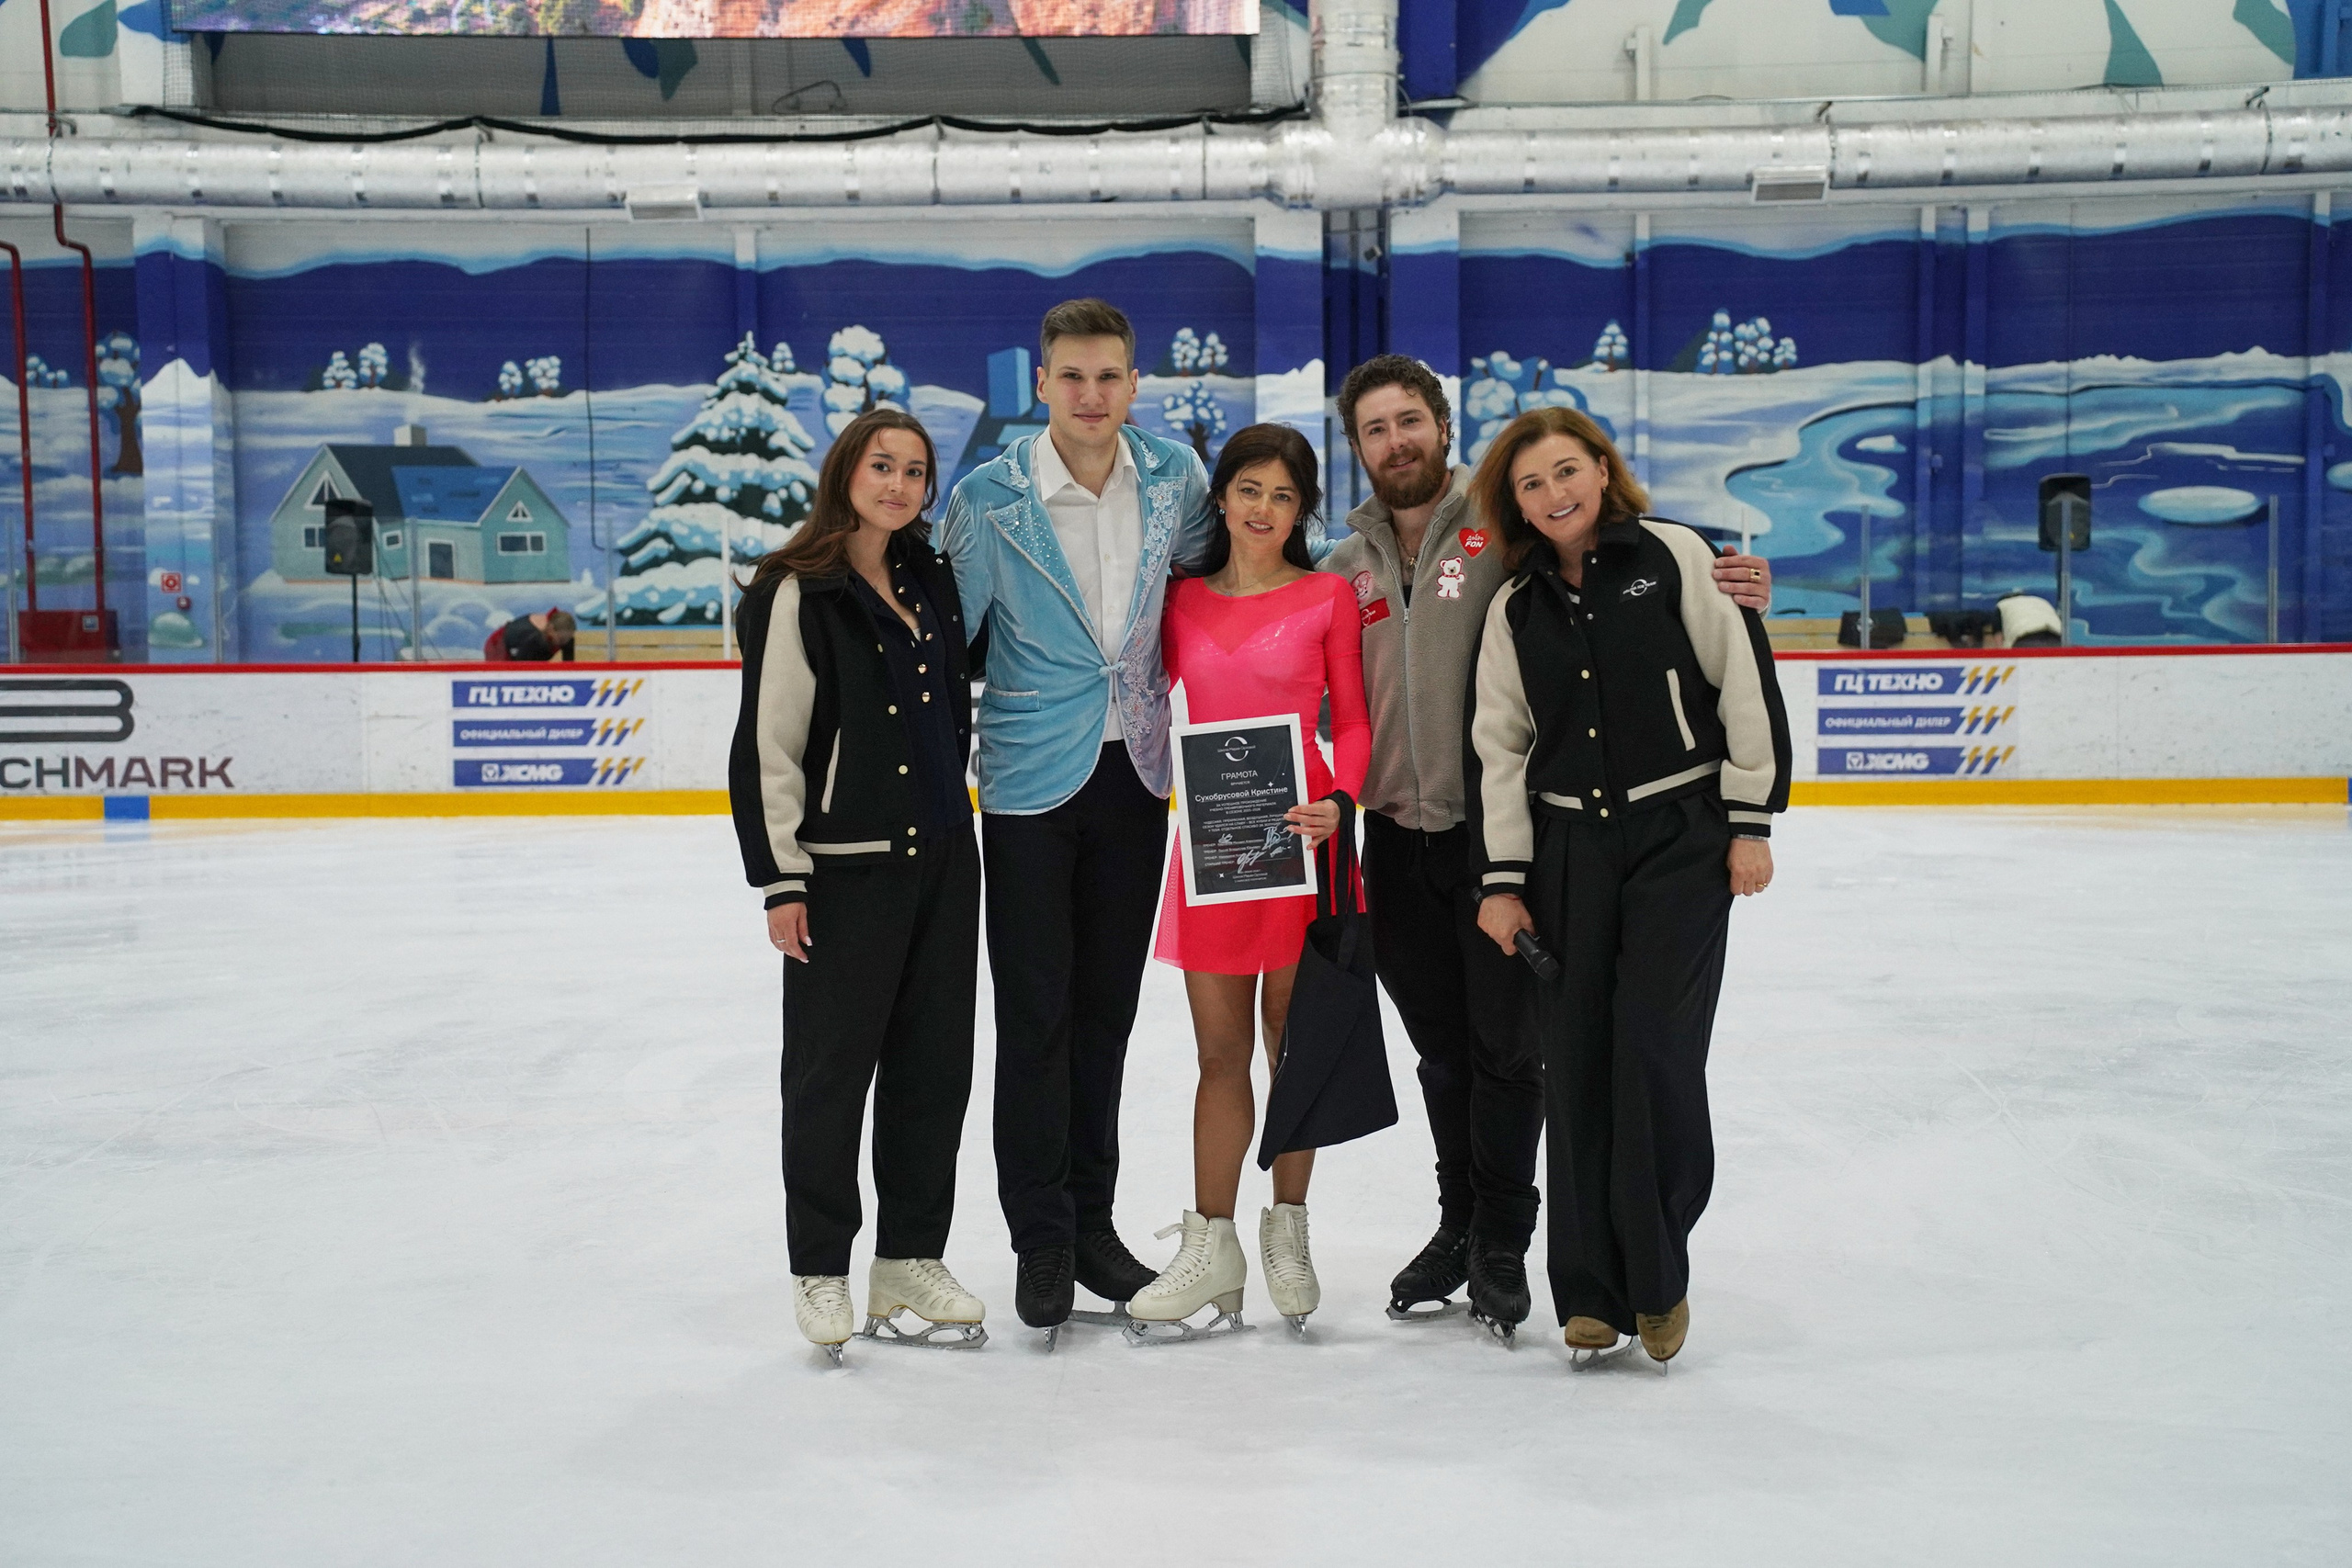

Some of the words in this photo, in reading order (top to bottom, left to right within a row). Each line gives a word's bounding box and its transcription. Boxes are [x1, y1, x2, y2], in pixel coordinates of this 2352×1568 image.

[1835, 673, 1864, 694] ГЦ
[1867, 672, 1944, 691] ТЕХНО
[469, 686, 498, 705] ГЦ
[501, 685, 575, 704] ТЕХНО
[1825, 716, 1913, 728] ОФИЦИАЛЬНЫЙ
[1914, 716, 1951, 728] ДИЛЕР
[459, 727, 547, 739] ОФИЦИАЛЬНЫЙ
[548, 728, 584, 739] ДИЛЕР
[1863, 753, 1930, 772] XCMG
[499, 763, 564, 782] XCMG
[1221, 771, 1258, 780] ГРАМОТА
[1195, 790, 1250, 803] Сухобрусовой
[1251, 786, 1288, 796] Кристине
